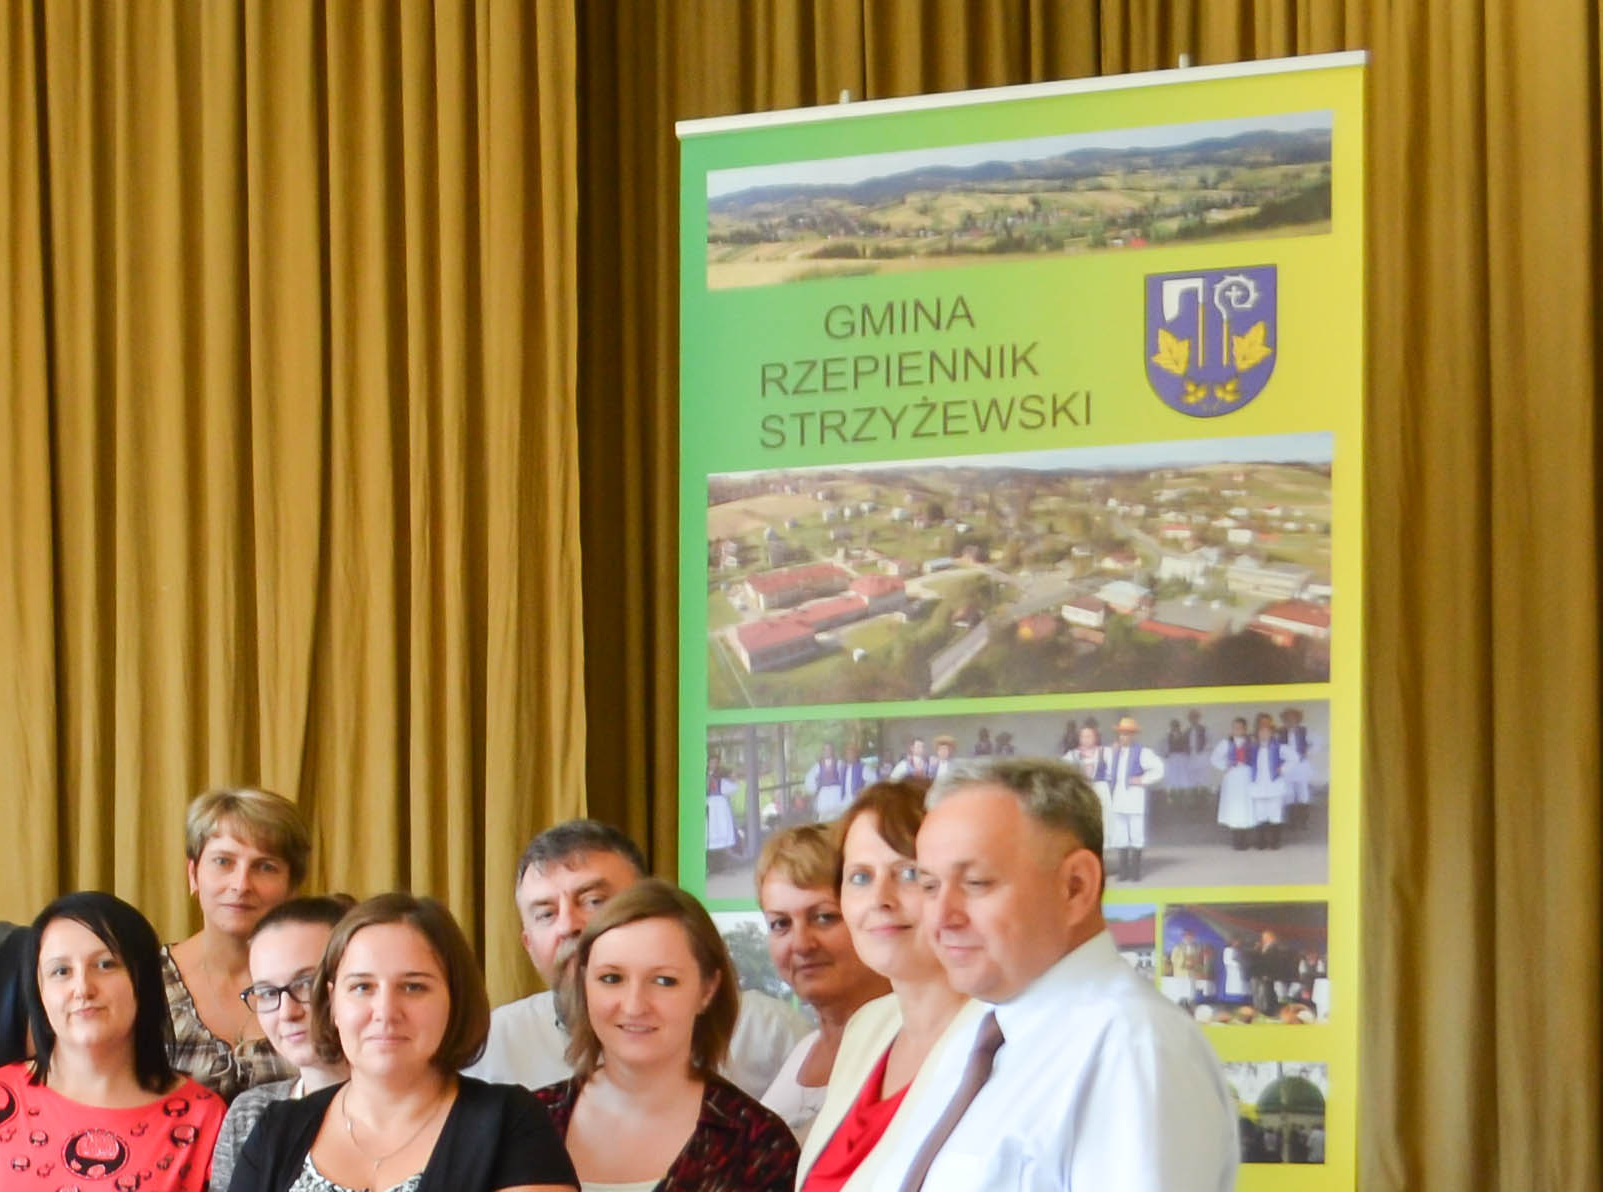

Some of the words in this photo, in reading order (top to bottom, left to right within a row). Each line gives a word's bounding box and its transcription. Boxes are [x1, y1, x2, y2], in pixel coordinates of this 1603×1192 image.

[823, 296, 975, 340] GMINA
[760, 342, 1040, 398] RZEPIENNIK
[759, 391, 1093, 450] STRZYŻEWSKI
